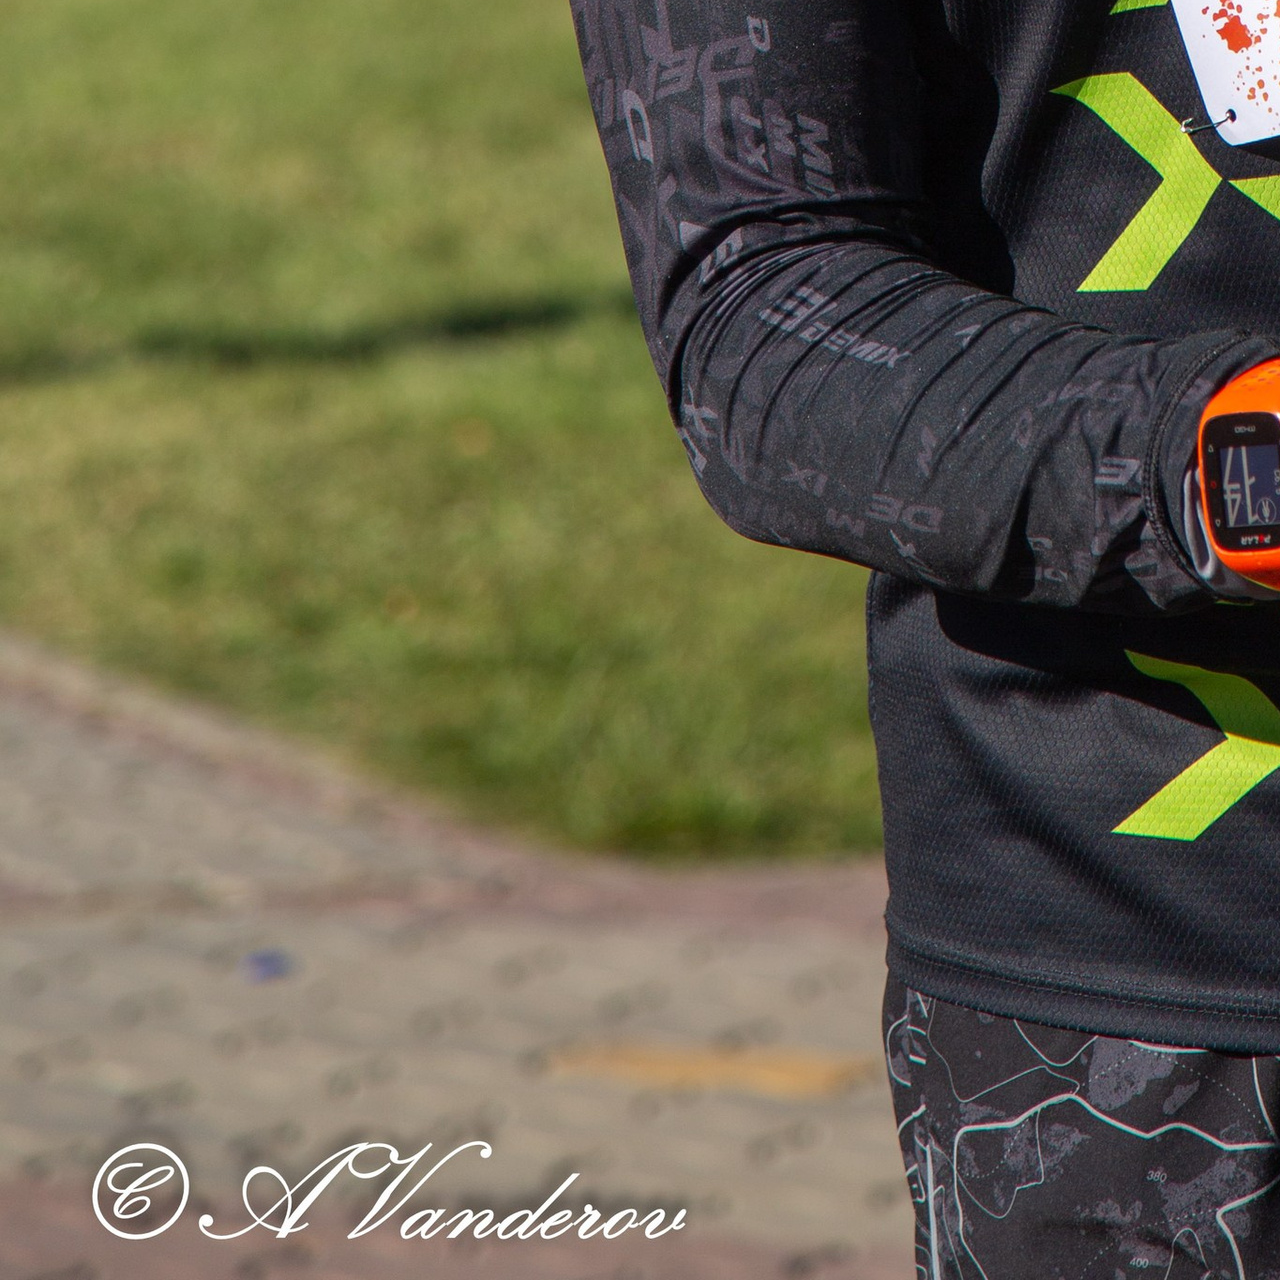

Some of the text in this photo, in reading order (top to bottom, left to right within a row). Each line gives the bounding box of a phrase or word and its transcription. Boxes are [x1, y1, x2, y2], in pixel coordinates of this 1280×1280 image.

[1240, 533, 1272, 546] POLAR
[1146, 1170, 1168, 1183] 380
[1129, 1257, 1150, 1269] 400
